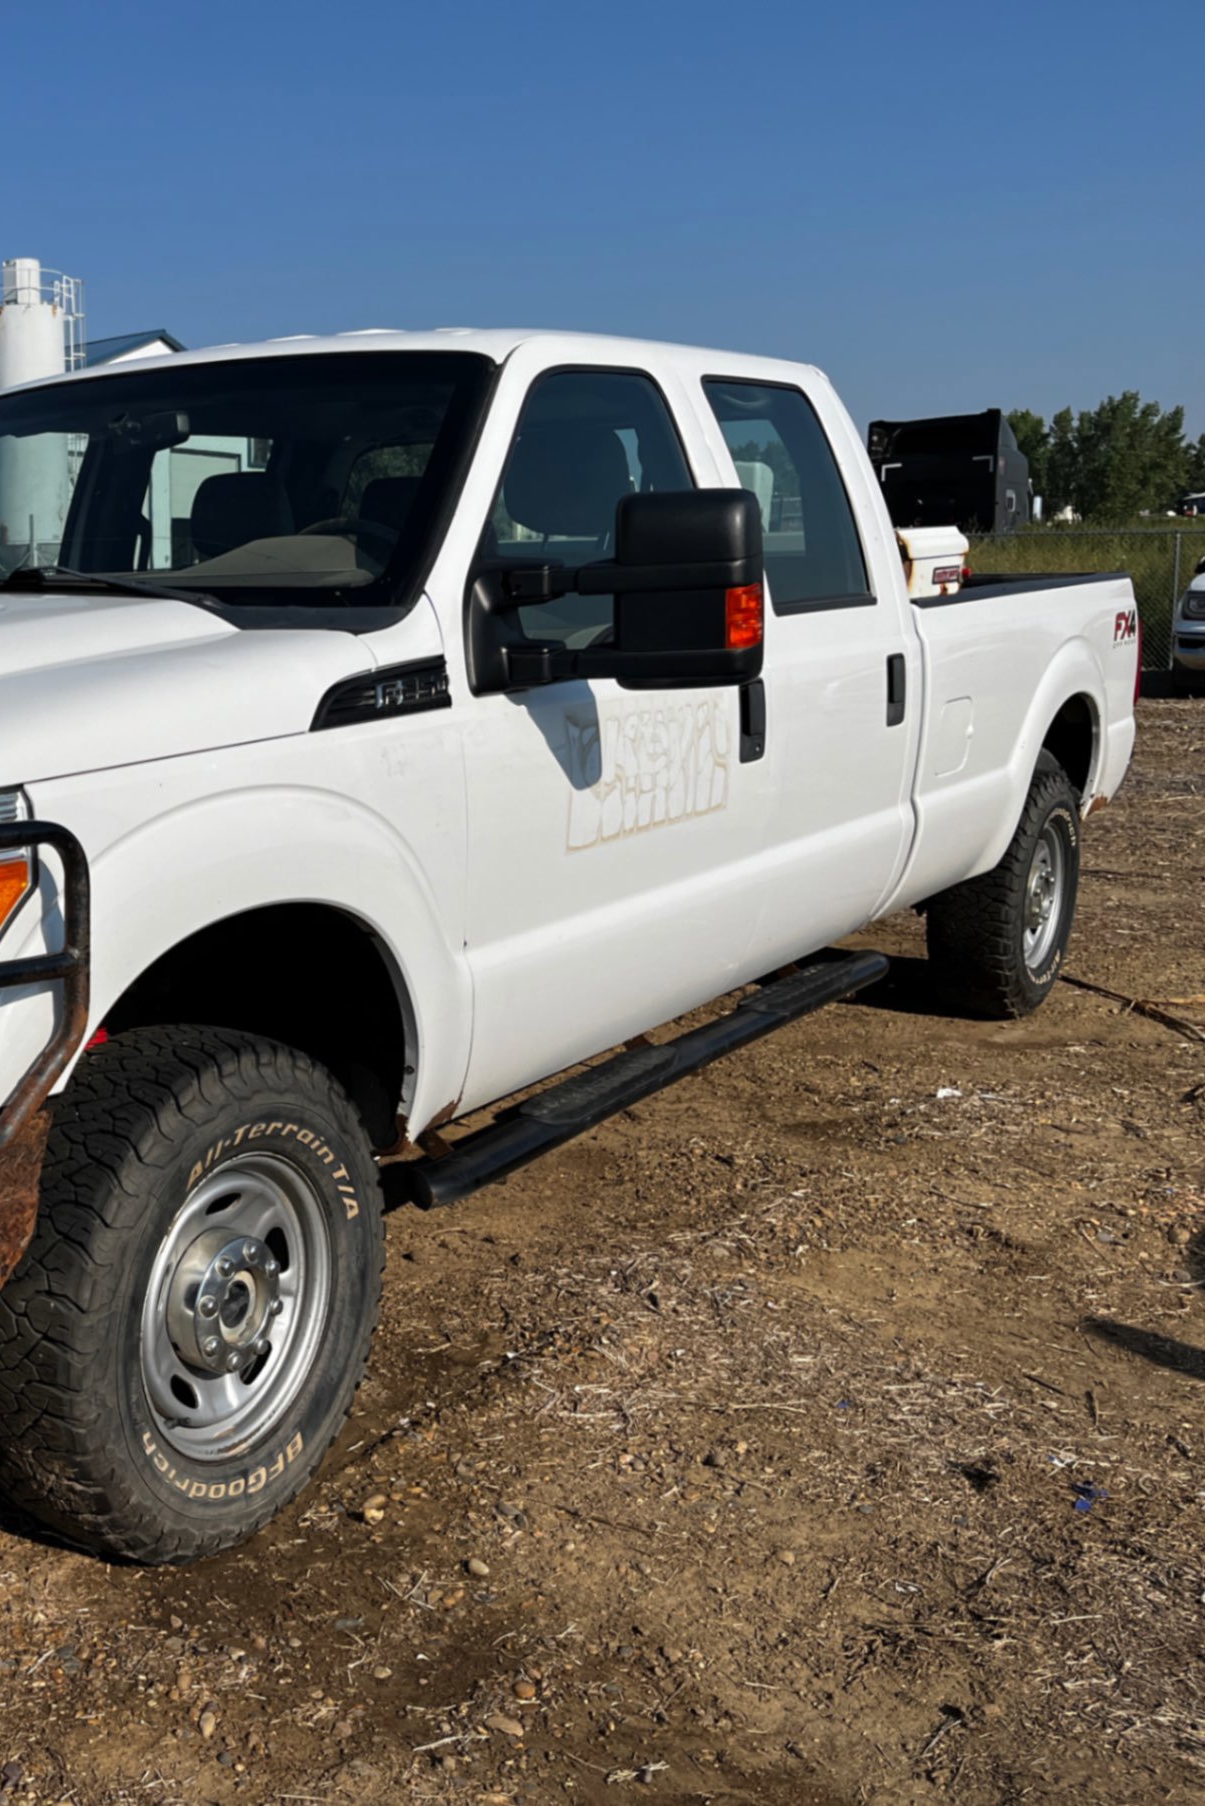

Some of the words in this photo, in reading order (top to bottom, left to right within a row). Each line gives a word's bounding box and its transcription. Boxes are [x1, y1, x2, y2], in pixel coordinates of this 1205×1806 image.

[1114, 609, 1136, 641] FX4
[185, 1121, 336, 1193] All-Terrain
[331, 1162, 360, 1220] T/A
[142, 1431, 304, 1499] BFGoodrich
